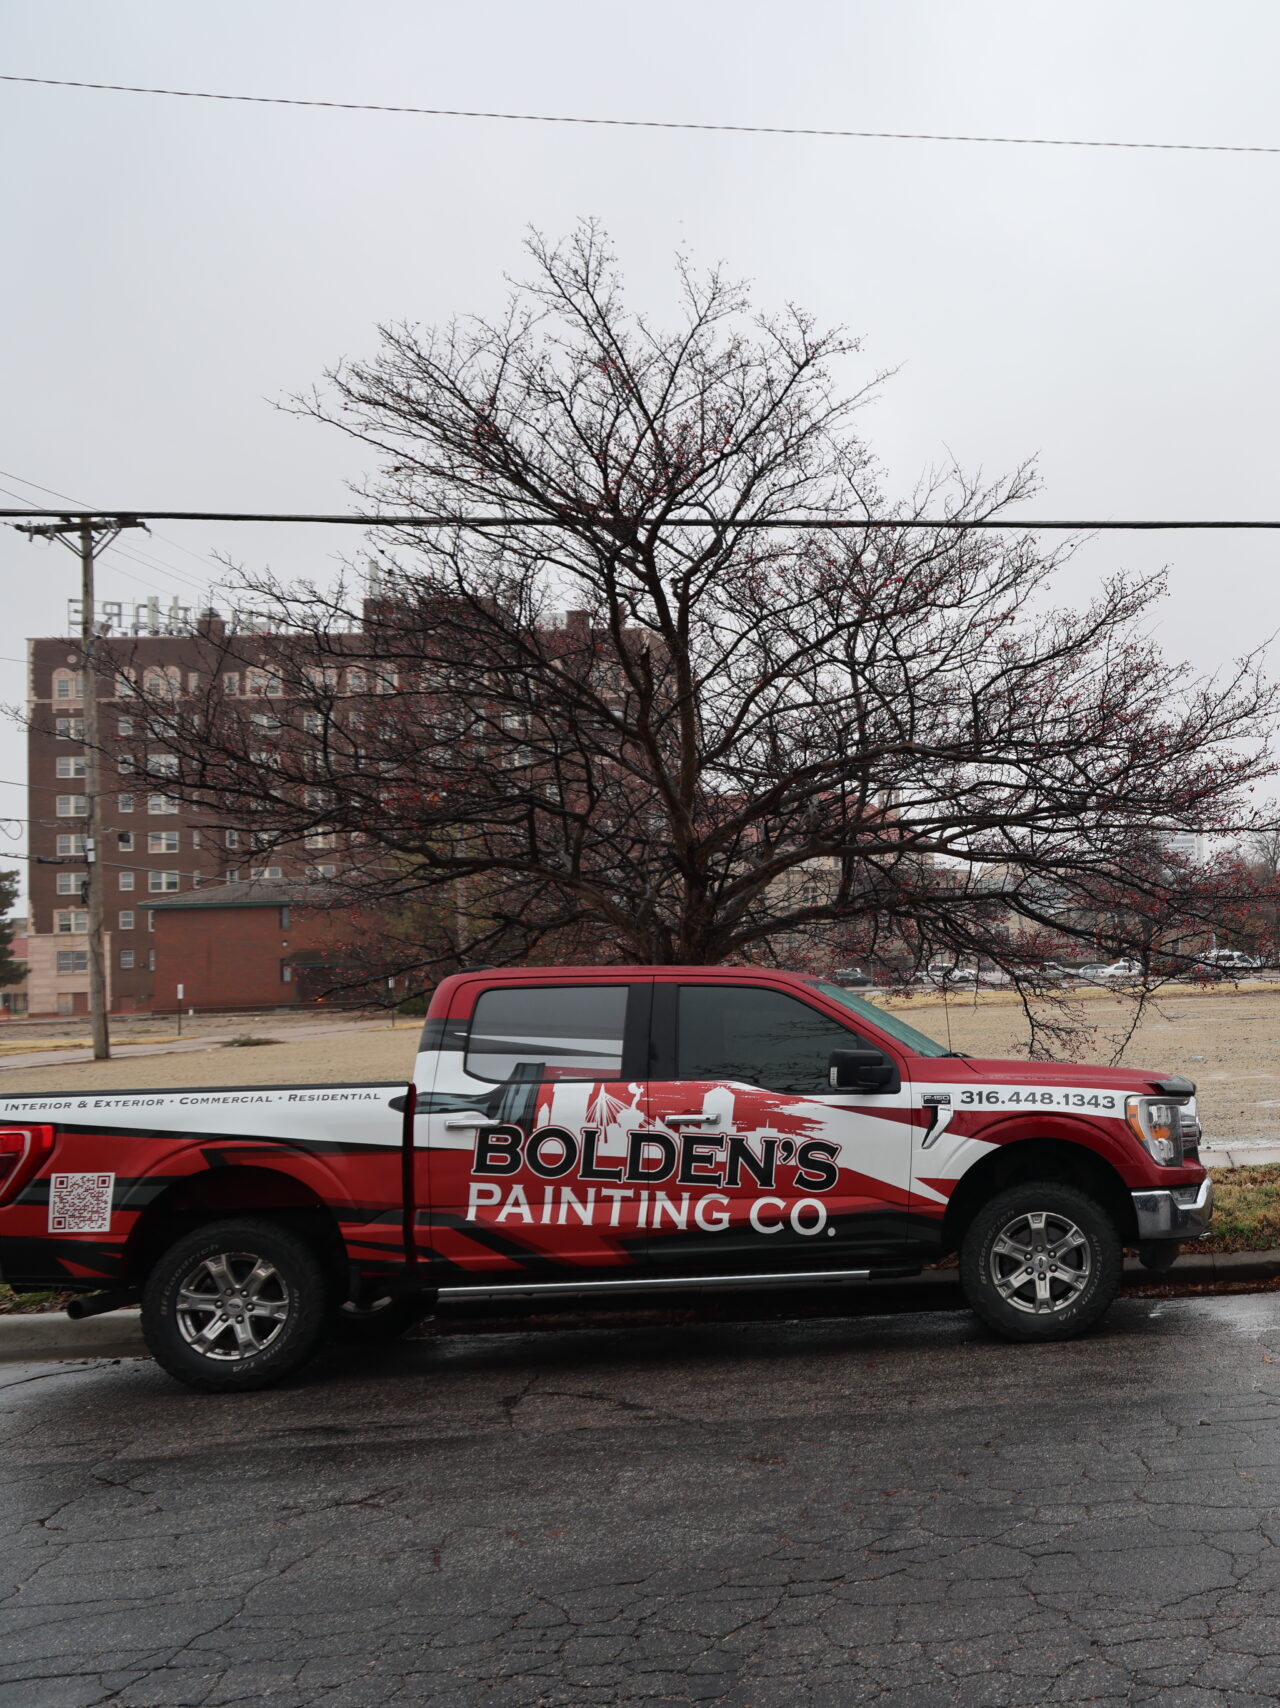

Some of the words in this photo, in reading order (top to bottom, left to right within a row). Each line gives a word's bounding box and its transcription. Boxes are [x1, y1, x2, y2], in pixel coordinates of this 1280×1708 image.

[4, 1102, 72, 1112] INTERIOR
[77, 1100, 87, 1109] &
[93, 1098, 164, 1108] EXTERIOR
[179, 1095, 273, 1105] COMMERCIAL
[288, 1093, 382, 1102] RESIDENTIAL
[960, 1090, 1116, 1110] 316.448.1343
[471, 1123, 842, 1192] BOLDEN'S
[465, 1182, 732, 1232] PAINTING
[749, 1196, 837, 1238] CO.
